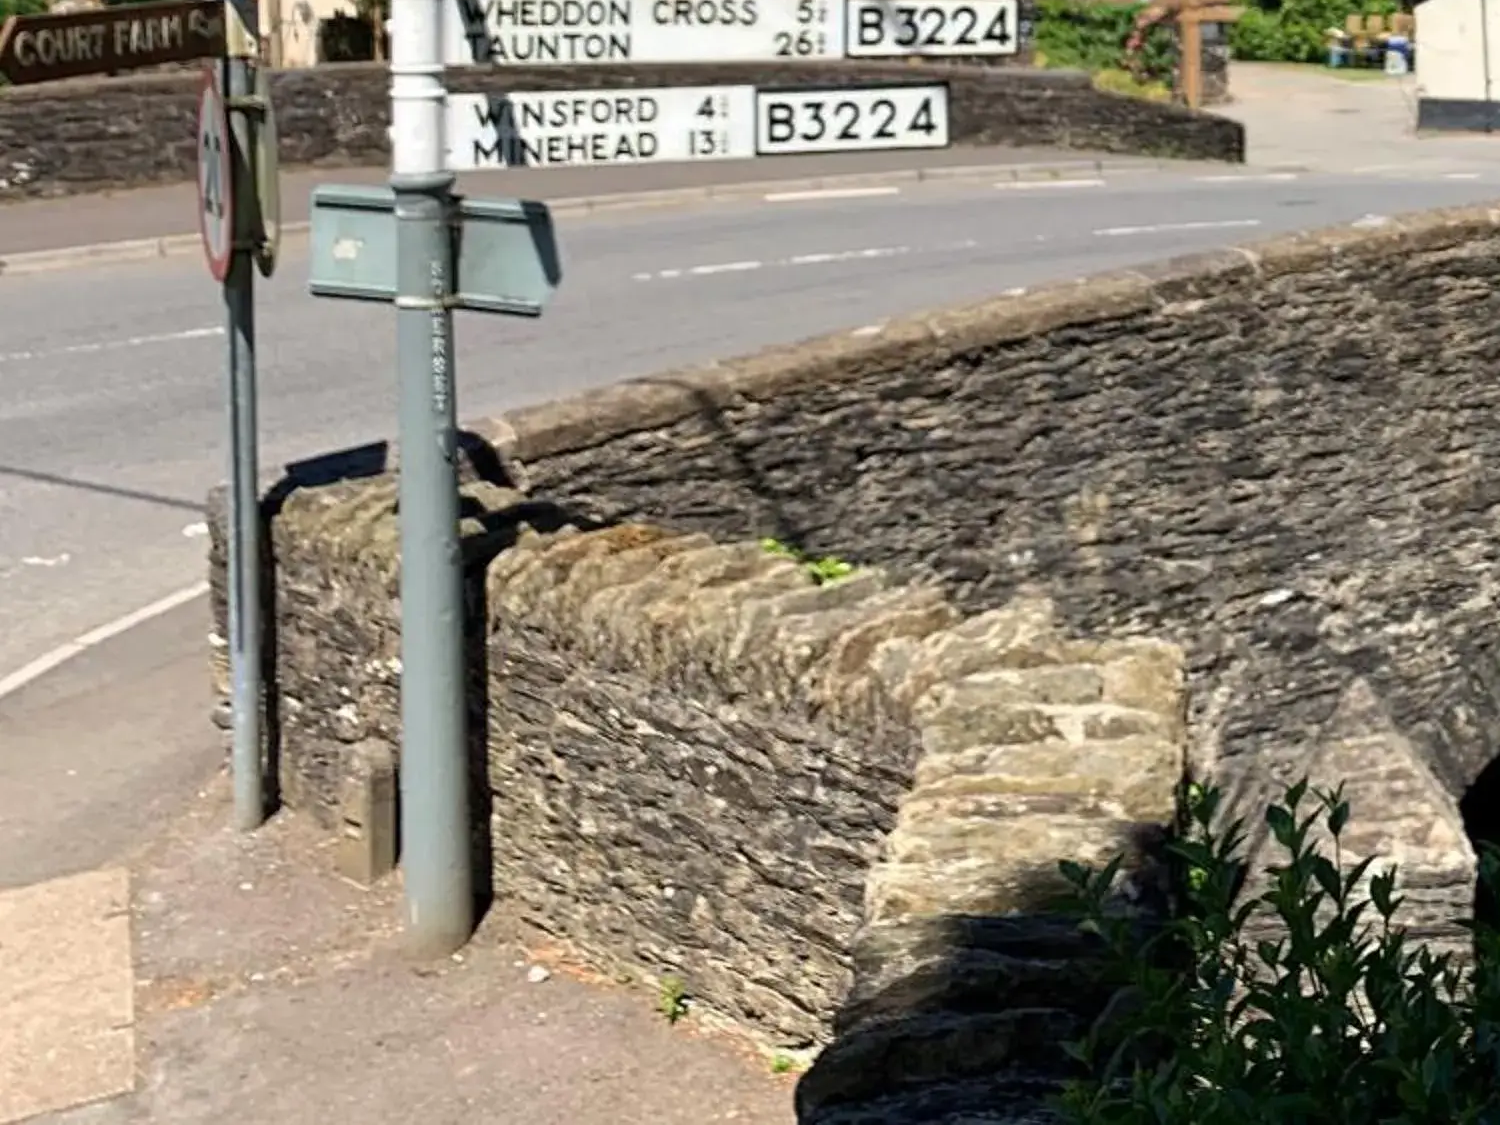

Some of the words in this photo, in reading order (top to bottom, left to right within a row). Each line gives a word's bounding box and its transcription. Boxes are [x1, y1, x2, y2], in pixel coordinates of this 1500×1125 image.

[13, 23, 107, 67] COURT
[113, 14, 183, 57] FARM
[465, 31, 632, 61] TAUNTON
[857, 5, 1011, 46] B3224
[767, 97, 938, 144] B3224
[473, 131, 658, 167] MINEHEAD
